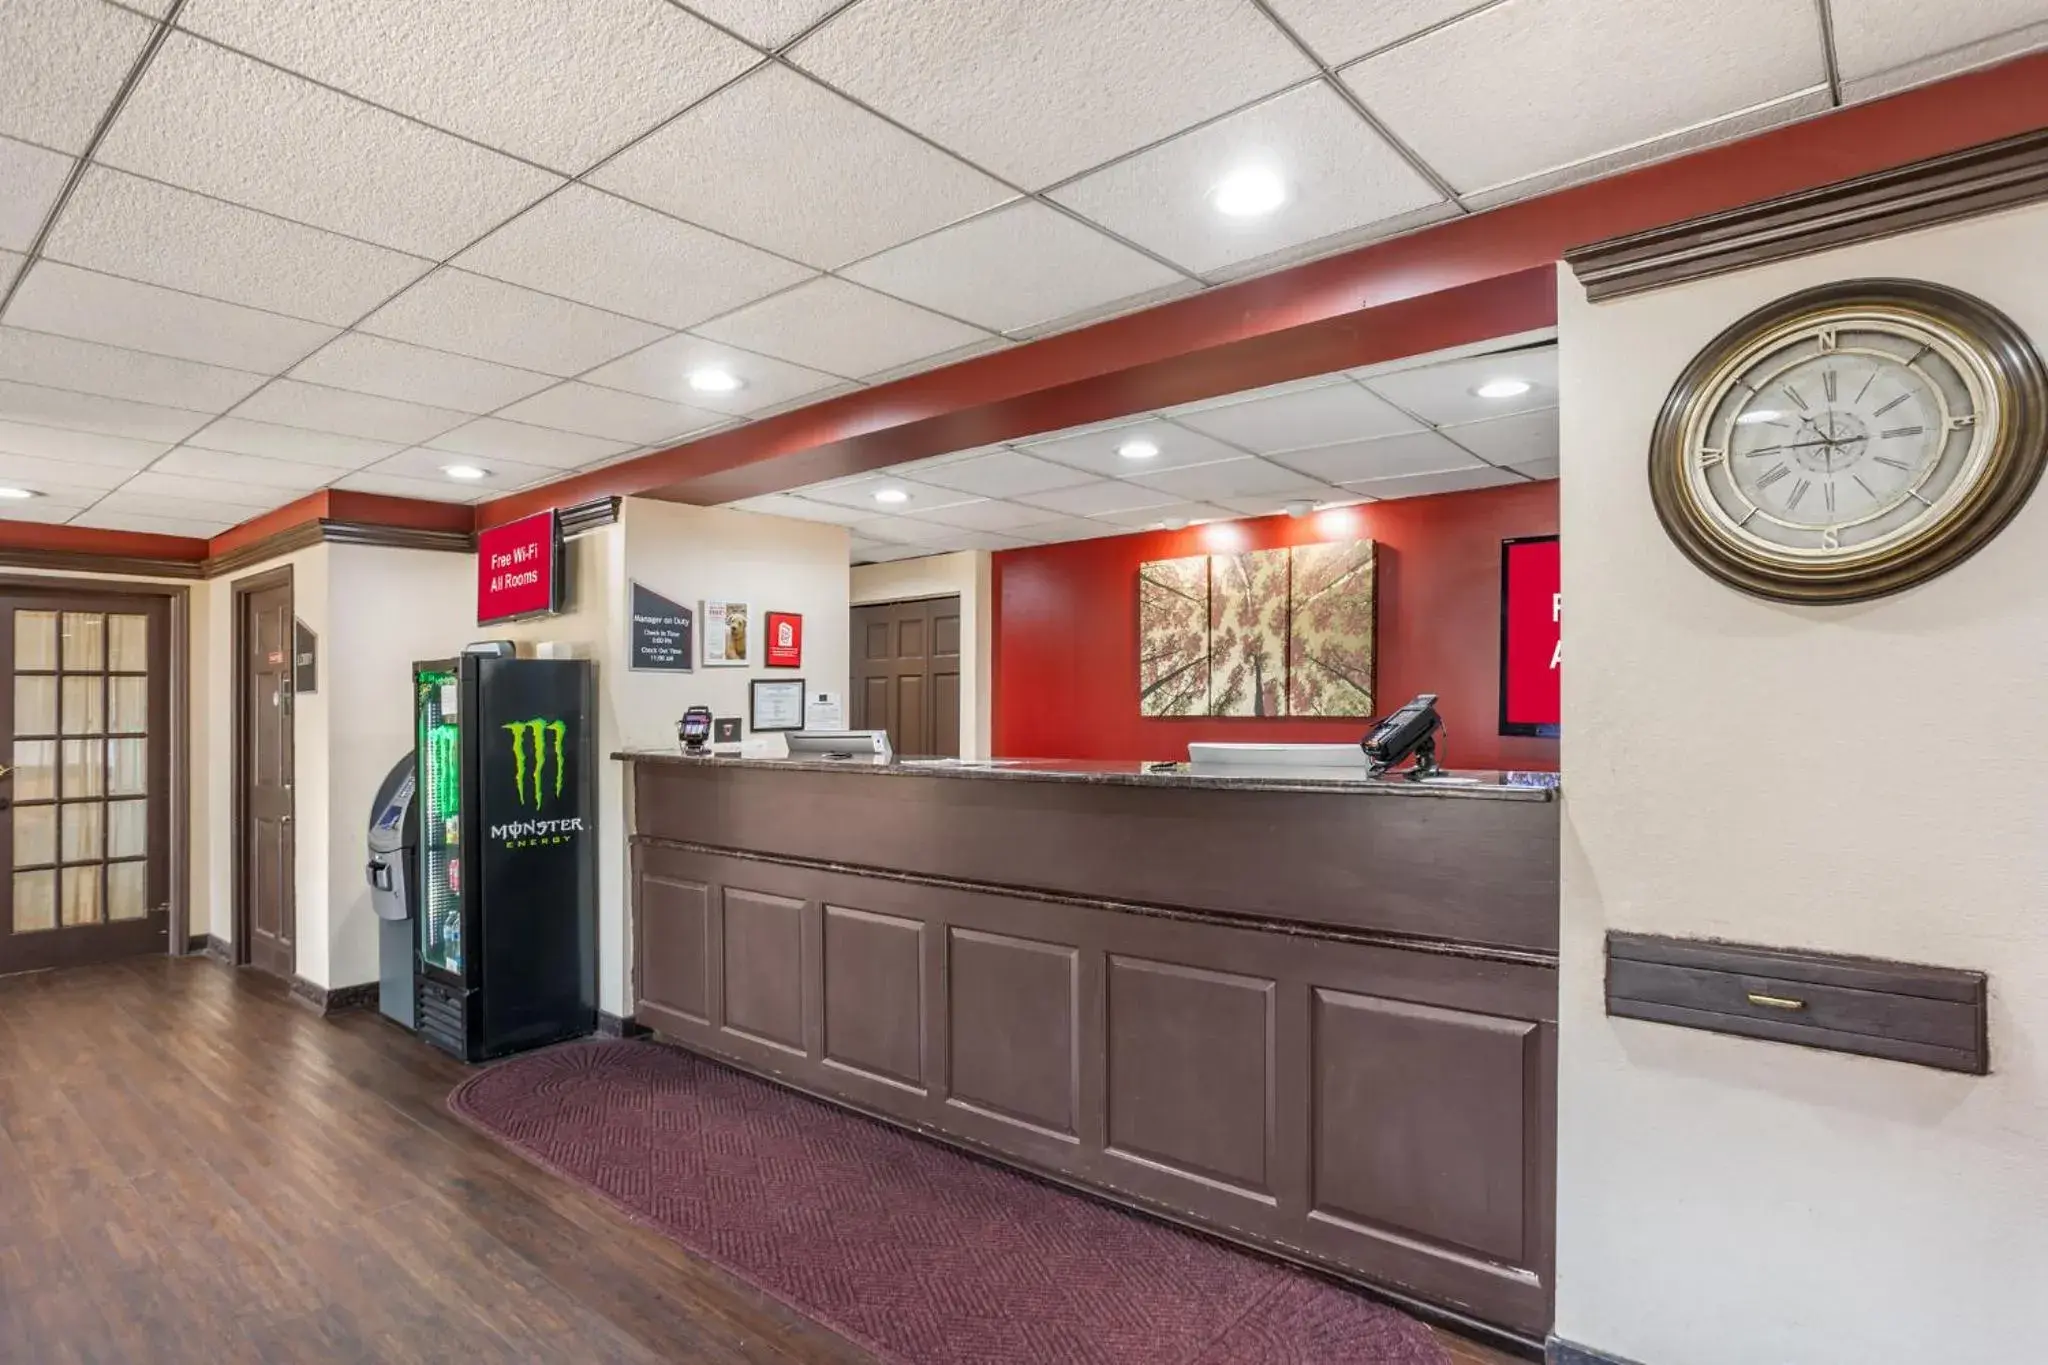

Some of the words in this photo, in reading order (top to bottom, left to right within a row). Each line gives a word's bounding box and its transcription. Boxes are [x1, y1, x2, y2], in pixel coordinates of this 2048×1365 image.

[491, 553, 512, 570] Free
[513, 542, 538, 564] Wi-Fi
[490, 577, 504, 593] All
[504, 570, 538, 589] Rooms
[634, 614, 662, 624] Manager
[673, 616, 689, 627] Duty
[490, 818, 584, 840] MONSTER
[505, 836, 571, 849] ENERGY
